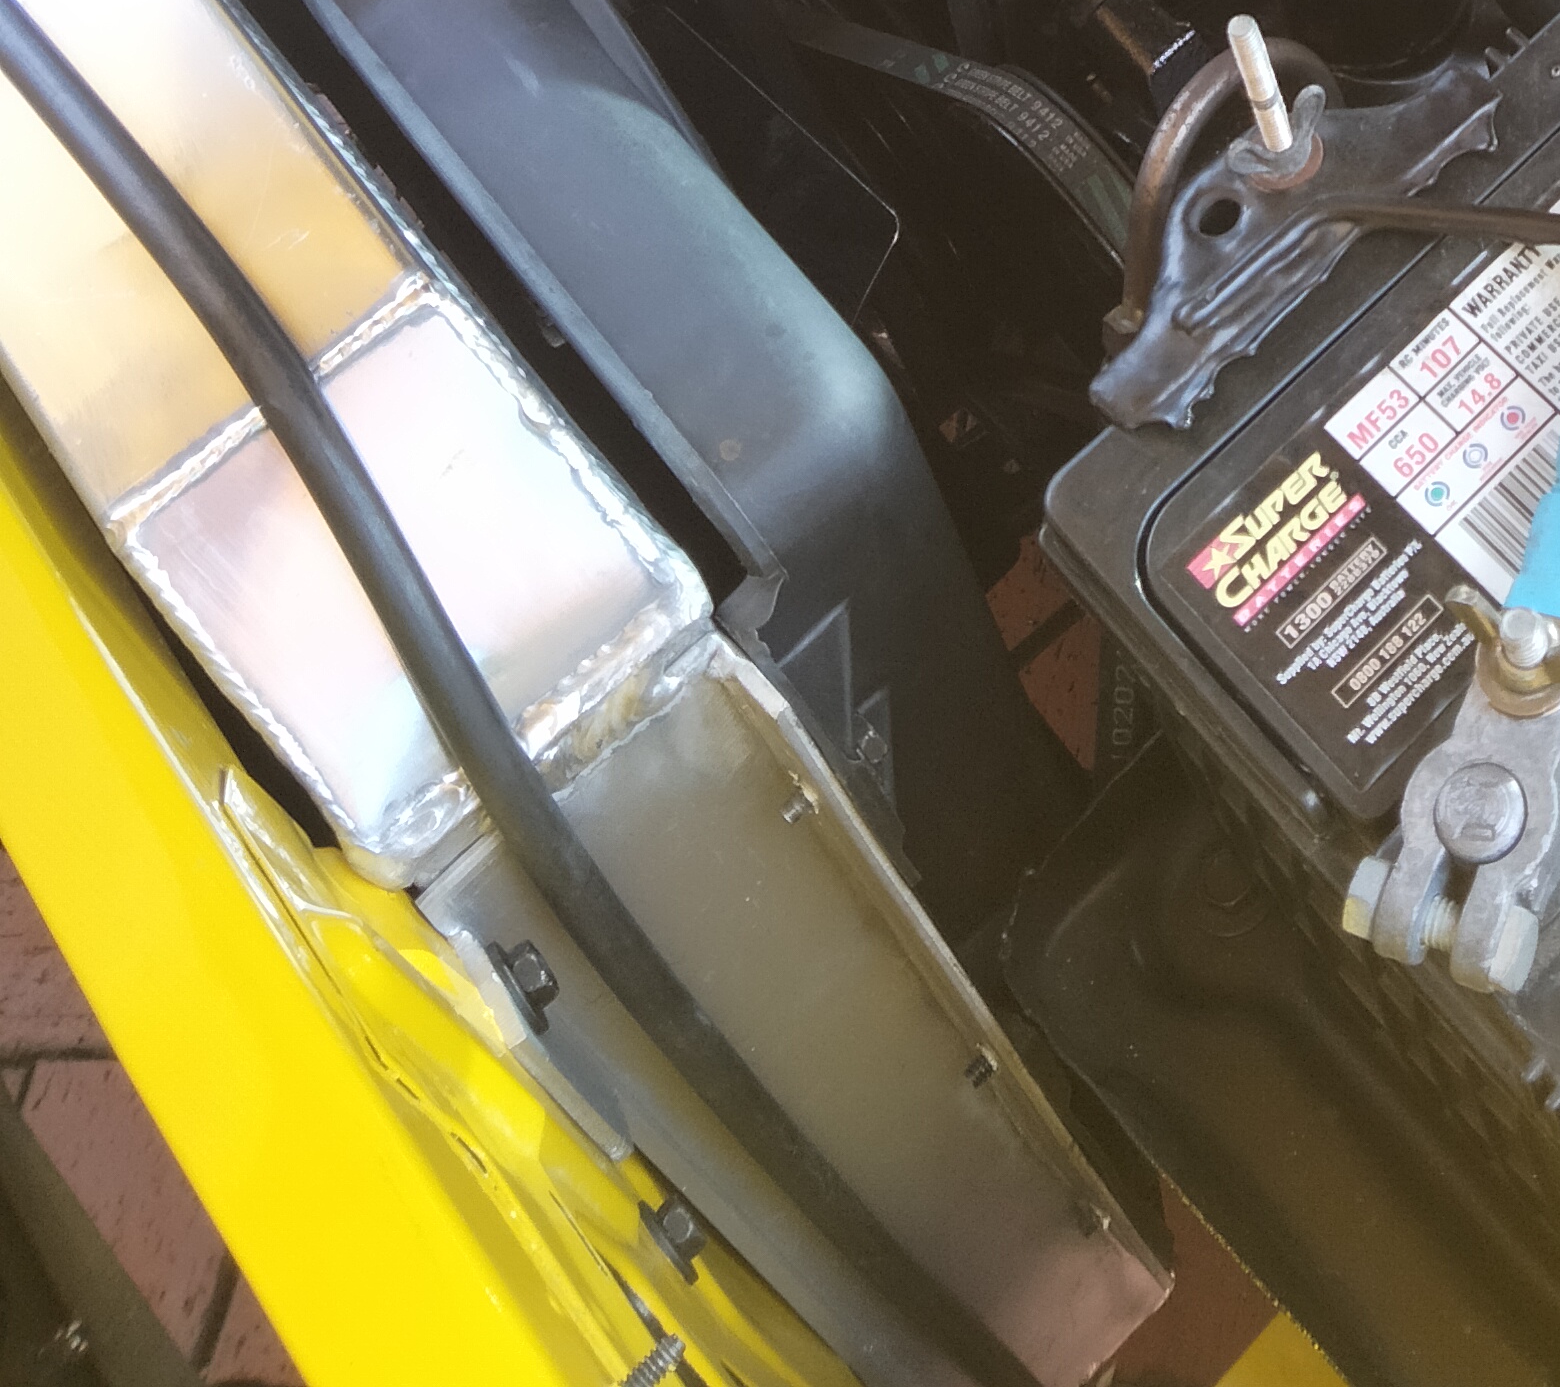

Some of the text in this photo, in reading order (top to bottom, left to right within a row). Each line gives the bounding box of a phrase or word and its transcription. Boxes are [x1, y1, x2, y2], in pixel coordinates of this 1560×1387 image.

[1397, 316, 1450, 369] RC MINUTES
[1418, 334, 1464, 381] 107
[1503, 314, 1544, 355] PRIVATE
[1524, 351, 1549, 376] TAXI
[1538, 369, 1556, 388] The
[1345, 385, 1411, 451] MF53
[1455, 370, 1503, 419] 14.8
[1387, 427, 1409, 450] CCA
[1391, 429, 1441, 480] 650
[1219, 447, 1332, 560] SUPER
[1213, 476, 1351, 613] CHARGE
[1237, 496, 1363, 624] BATTERIES
[1328, 543, 1375, 590] BATTERY
[1275, 552, 1409, 686] Supplied by: SuperCharge Batteries
[1282, 589, 1335, 642] 1300
[1318, 624, 1354, 660] Chicago
[1365, 567, 1411, 612] Blacktown
[1325, 644, 1349, 669] NSW
[1367, 587, 1407, 627] Australia
[1346, 610, 1427, 692] 0800 188 122
[1377, 653, 1419, 695] Westfield
[1360, 682, 1408, 729] Wellington
[1425, 642, 1447, 664] New
[1362, 631, 1478, 745] www.supercharge.com.au
